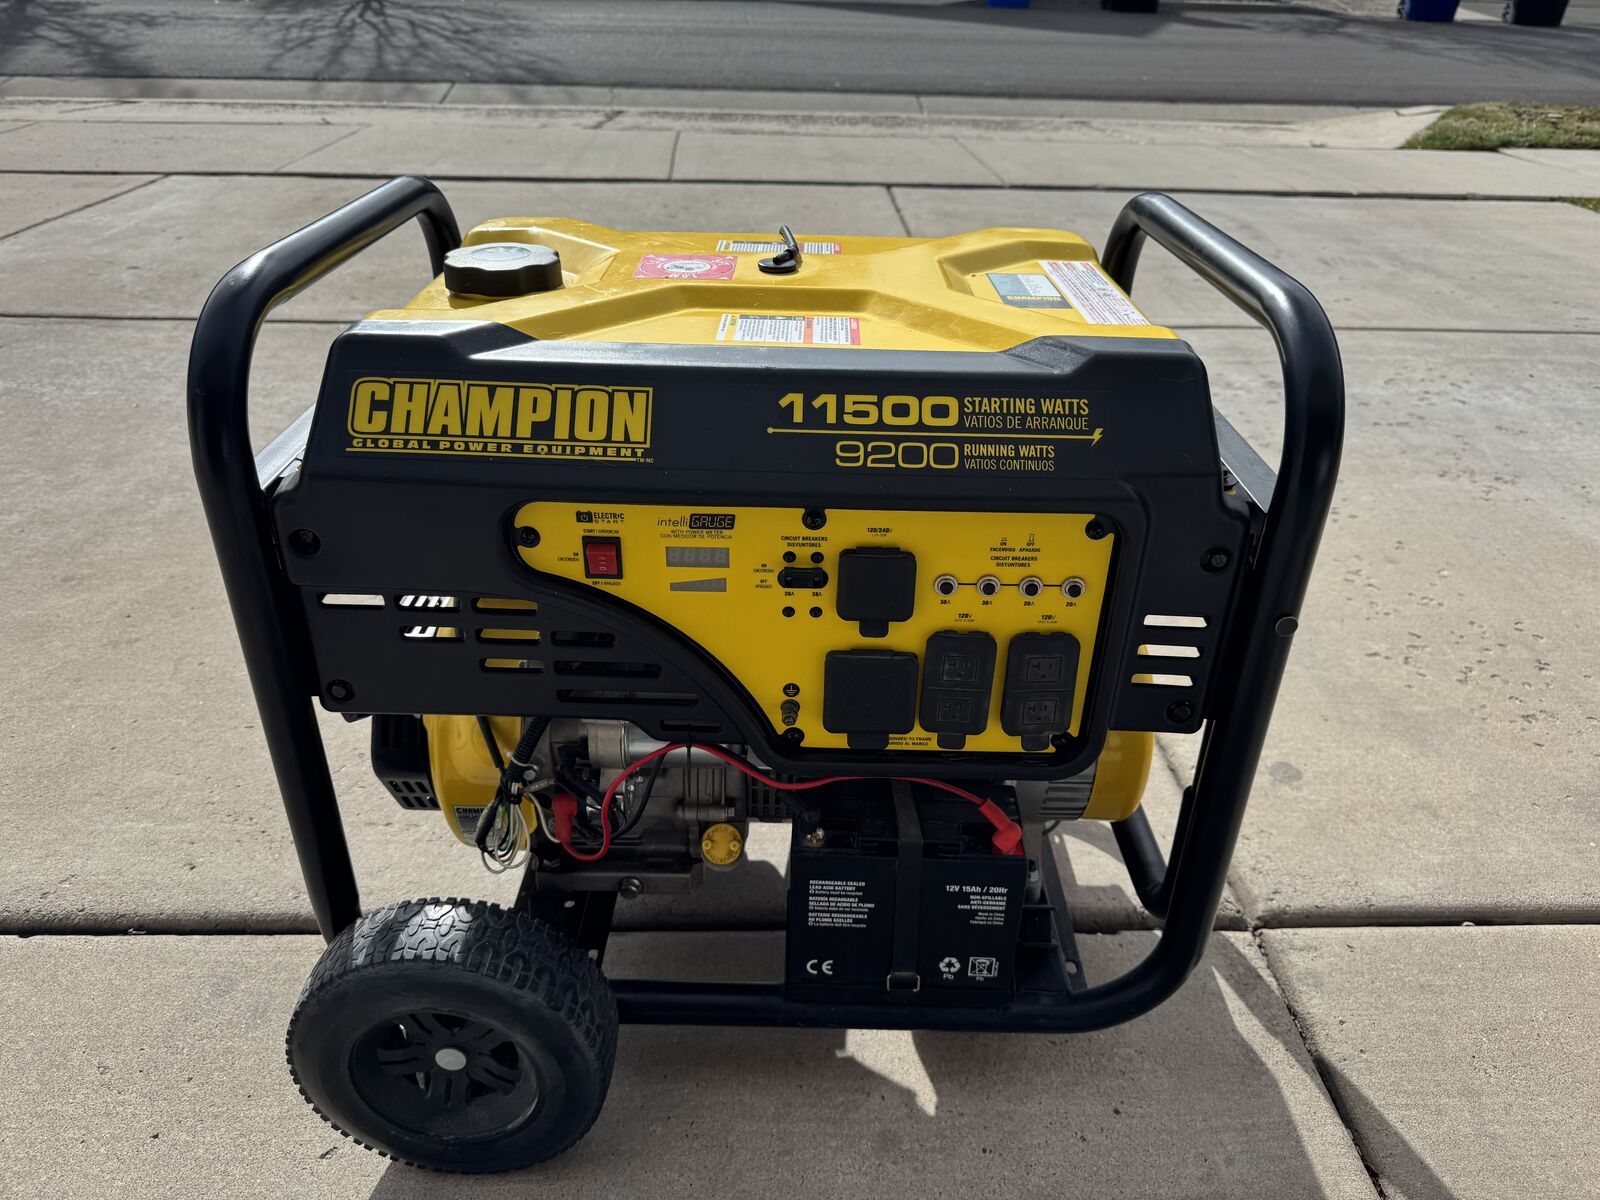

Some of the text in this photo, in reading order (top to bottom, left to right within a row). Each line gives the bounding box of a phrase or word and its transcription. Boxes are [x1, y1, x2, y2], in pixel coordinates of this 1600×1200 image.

[352, 382, 647, 442] CHAMPION
[778, 392, 960, 427] 11500
[964, 396, 1089, 415] STARTING WATTS
[964, 416, 1089, 431] VATIOS DE ARRANQUE
[352, 438, 645, 458] GLOBAL POWER EQUIPMENT
[835, 440, 958, 469] 9200
[964, 443, 1055, 458] RUNNING WATTS
[964, 459, 1055, 472] VATIOS CONTINUOS
[594, 512, 625, 520] ELECTRIC
[657, 514, 735, 529] intelliGAUGE
[806, 959, 833, 975] CE
